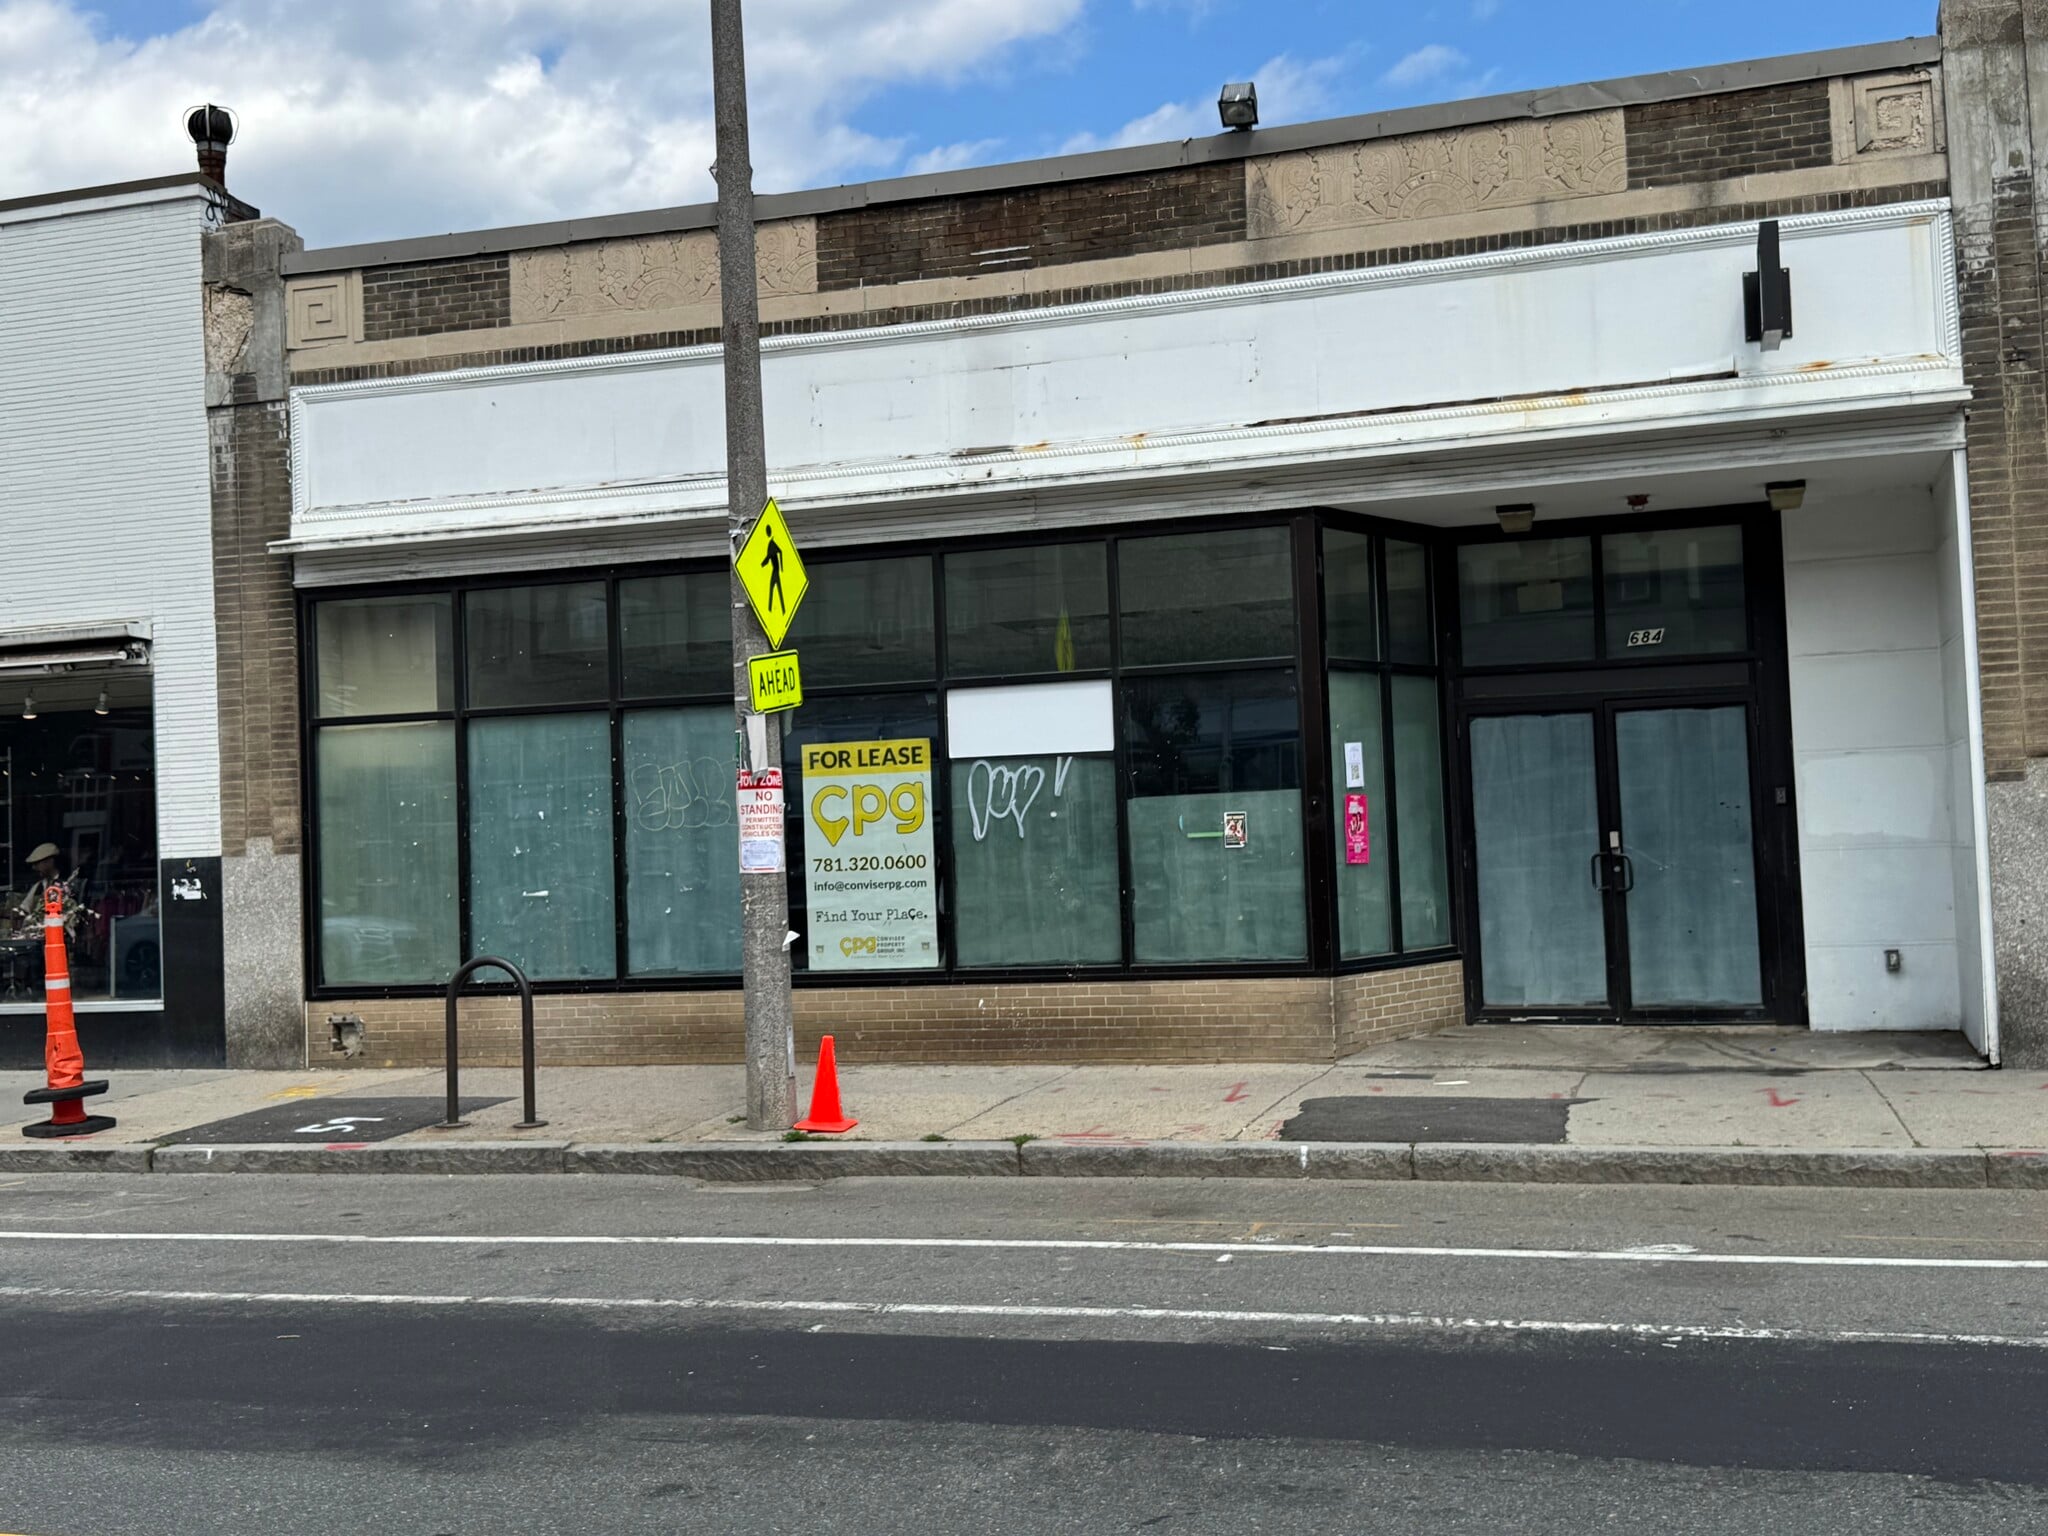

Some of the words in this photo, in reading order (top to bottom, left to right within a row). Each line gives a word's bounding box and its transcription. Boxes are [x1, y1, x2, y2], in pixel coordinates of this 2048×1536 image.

[1630, 630, 1662, 645] 684
[759, 667, 796, 697] AHEAD
[809, 750, 852, 770] FOR
[857, 746, 923, 767] LEASE
[760, 774, 782, 787] ZONE
[755, 791, 773, 801] NO
[740, 804, 783, 815] STANDING
[811, 781, 925, 847] cpg
[813, 854, 927, 873] 781.320.0600
[814, 880, 927, 892] info@conviserpg.com
[815, 910, 847, 923] Find
[851, 909, 882, 921] Your
[840, 936, 877, 957] cpg
